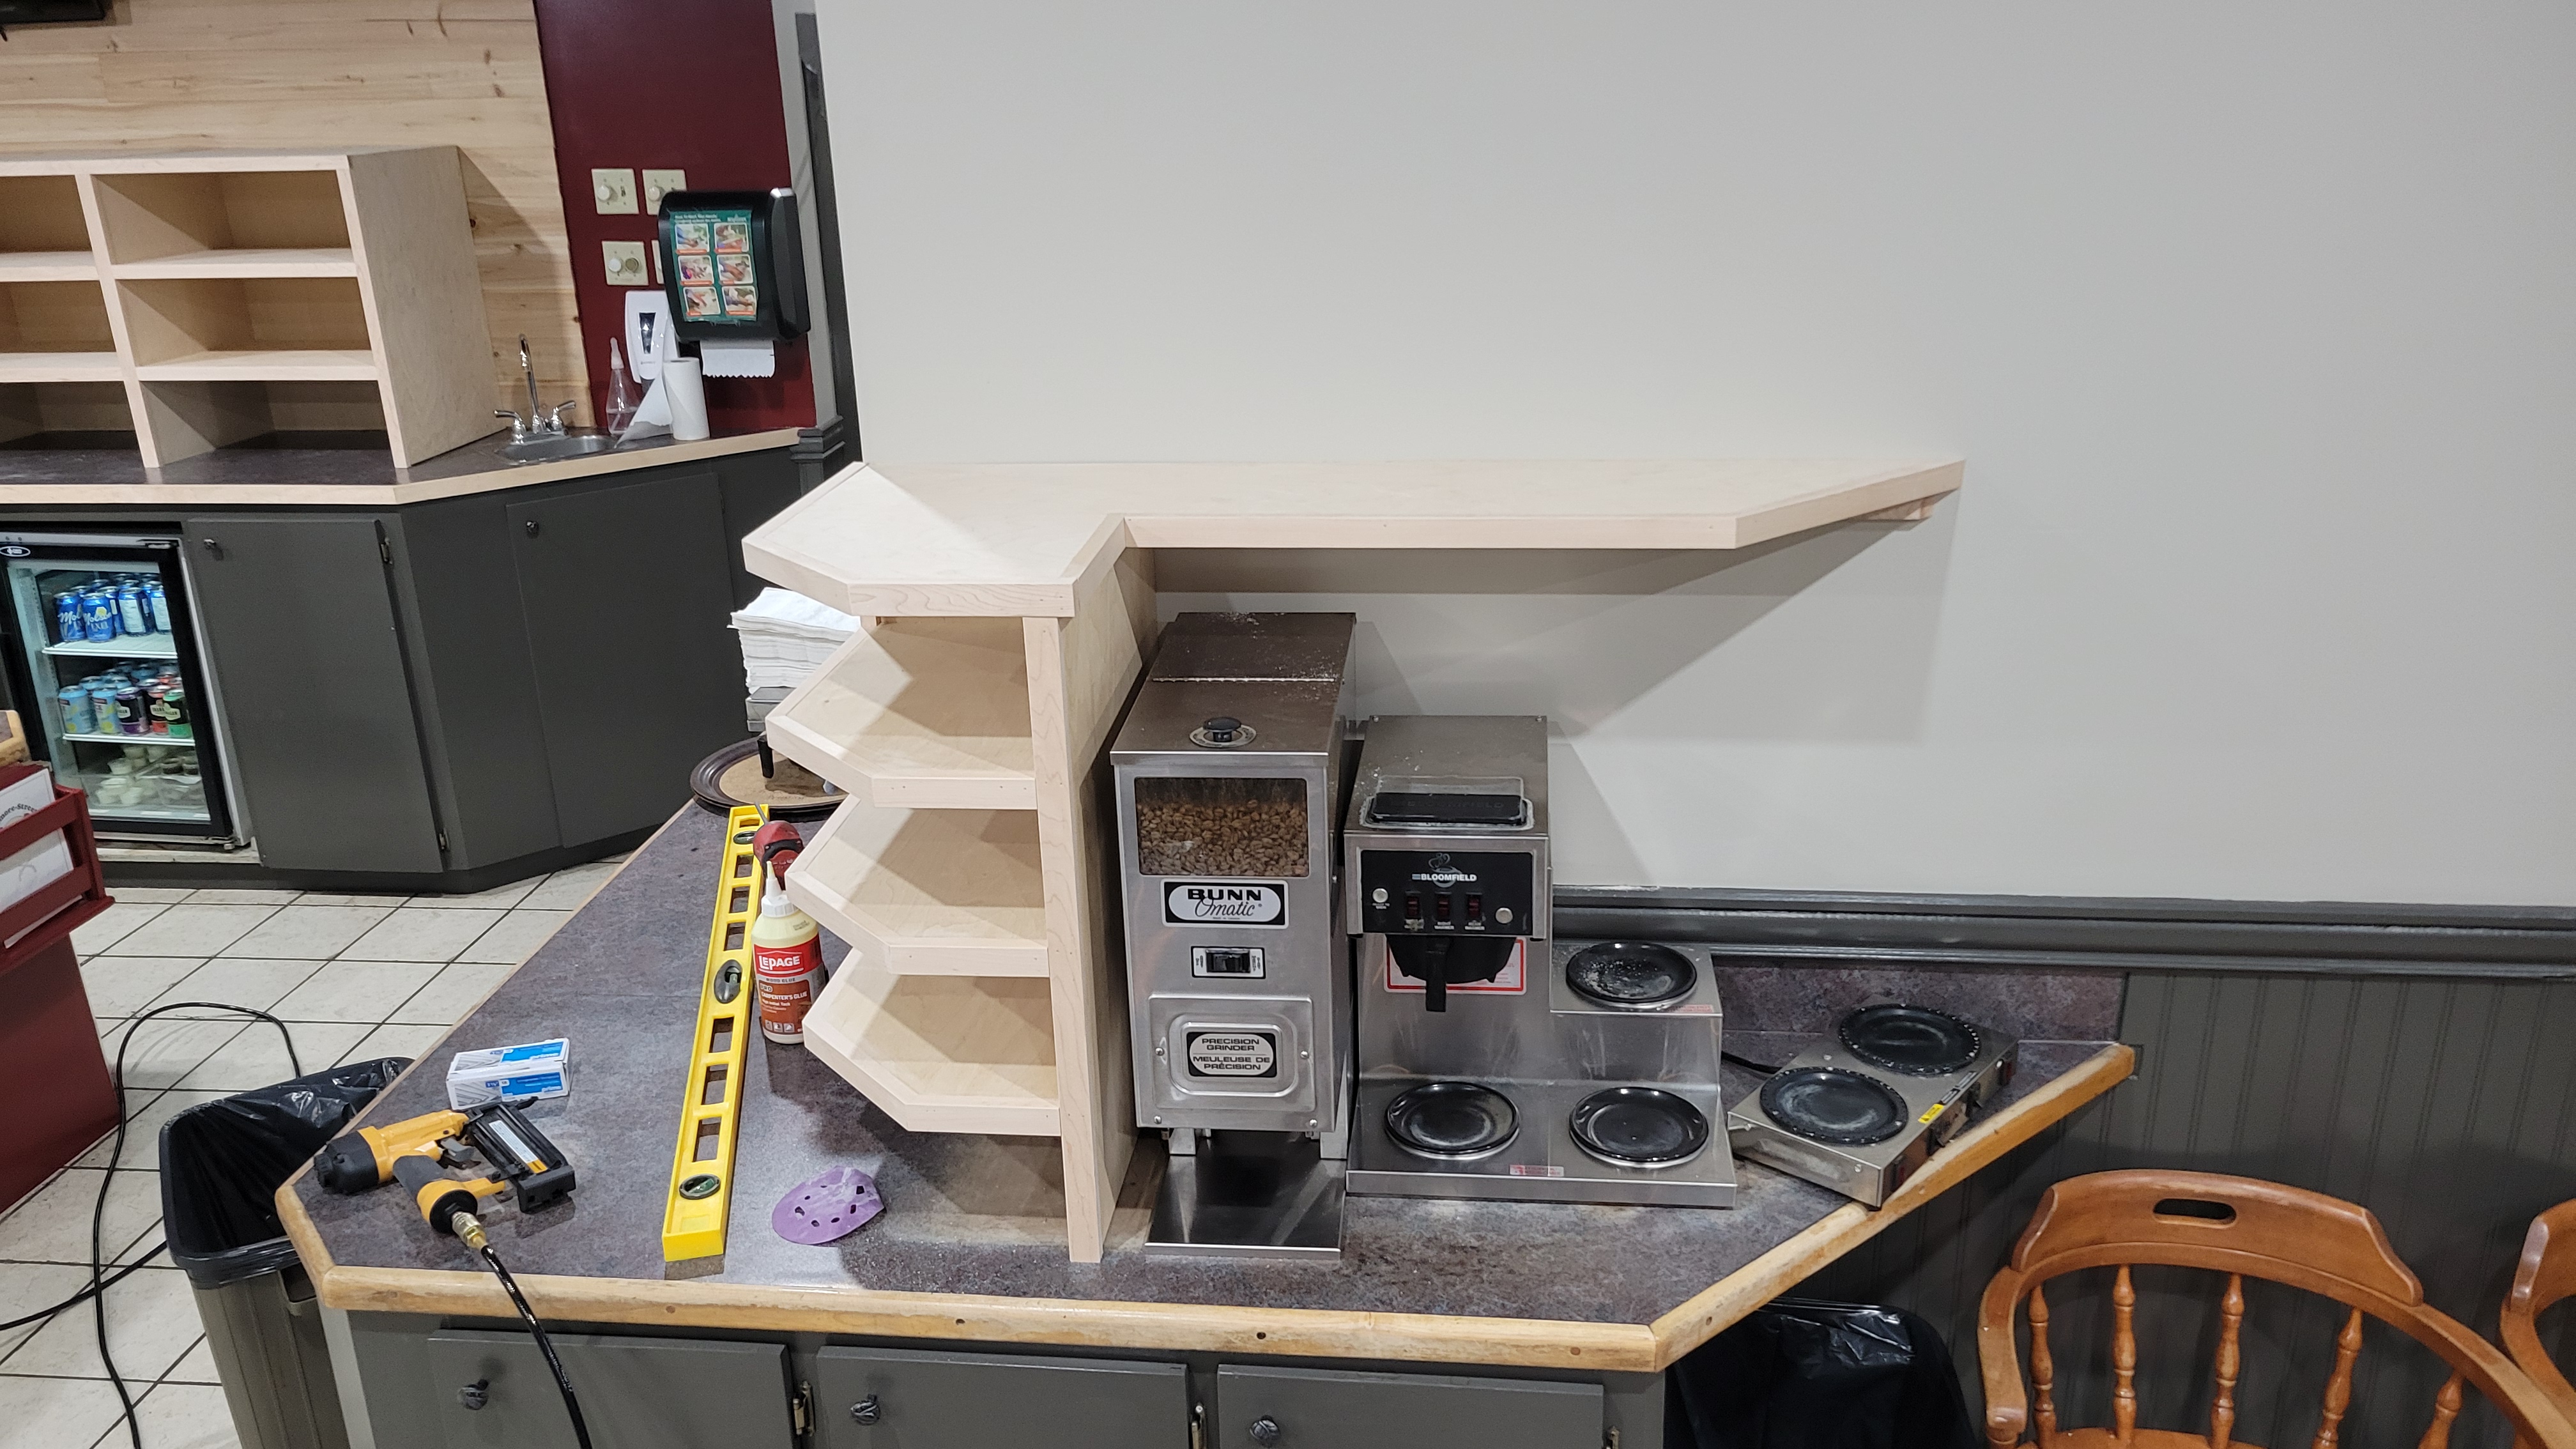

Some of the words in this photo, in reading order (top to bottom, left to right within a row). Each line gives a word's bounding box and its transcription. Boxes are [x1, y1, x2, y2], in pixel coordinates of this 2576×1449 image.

[1420, 873, 1477, 882] BLOOMFIELD
[1187, 889, 1261, 901] BUNN
[1195, 897, 1255, 917] Omatic
[1204, 1062, 1261, 1070] PRÉCISION
